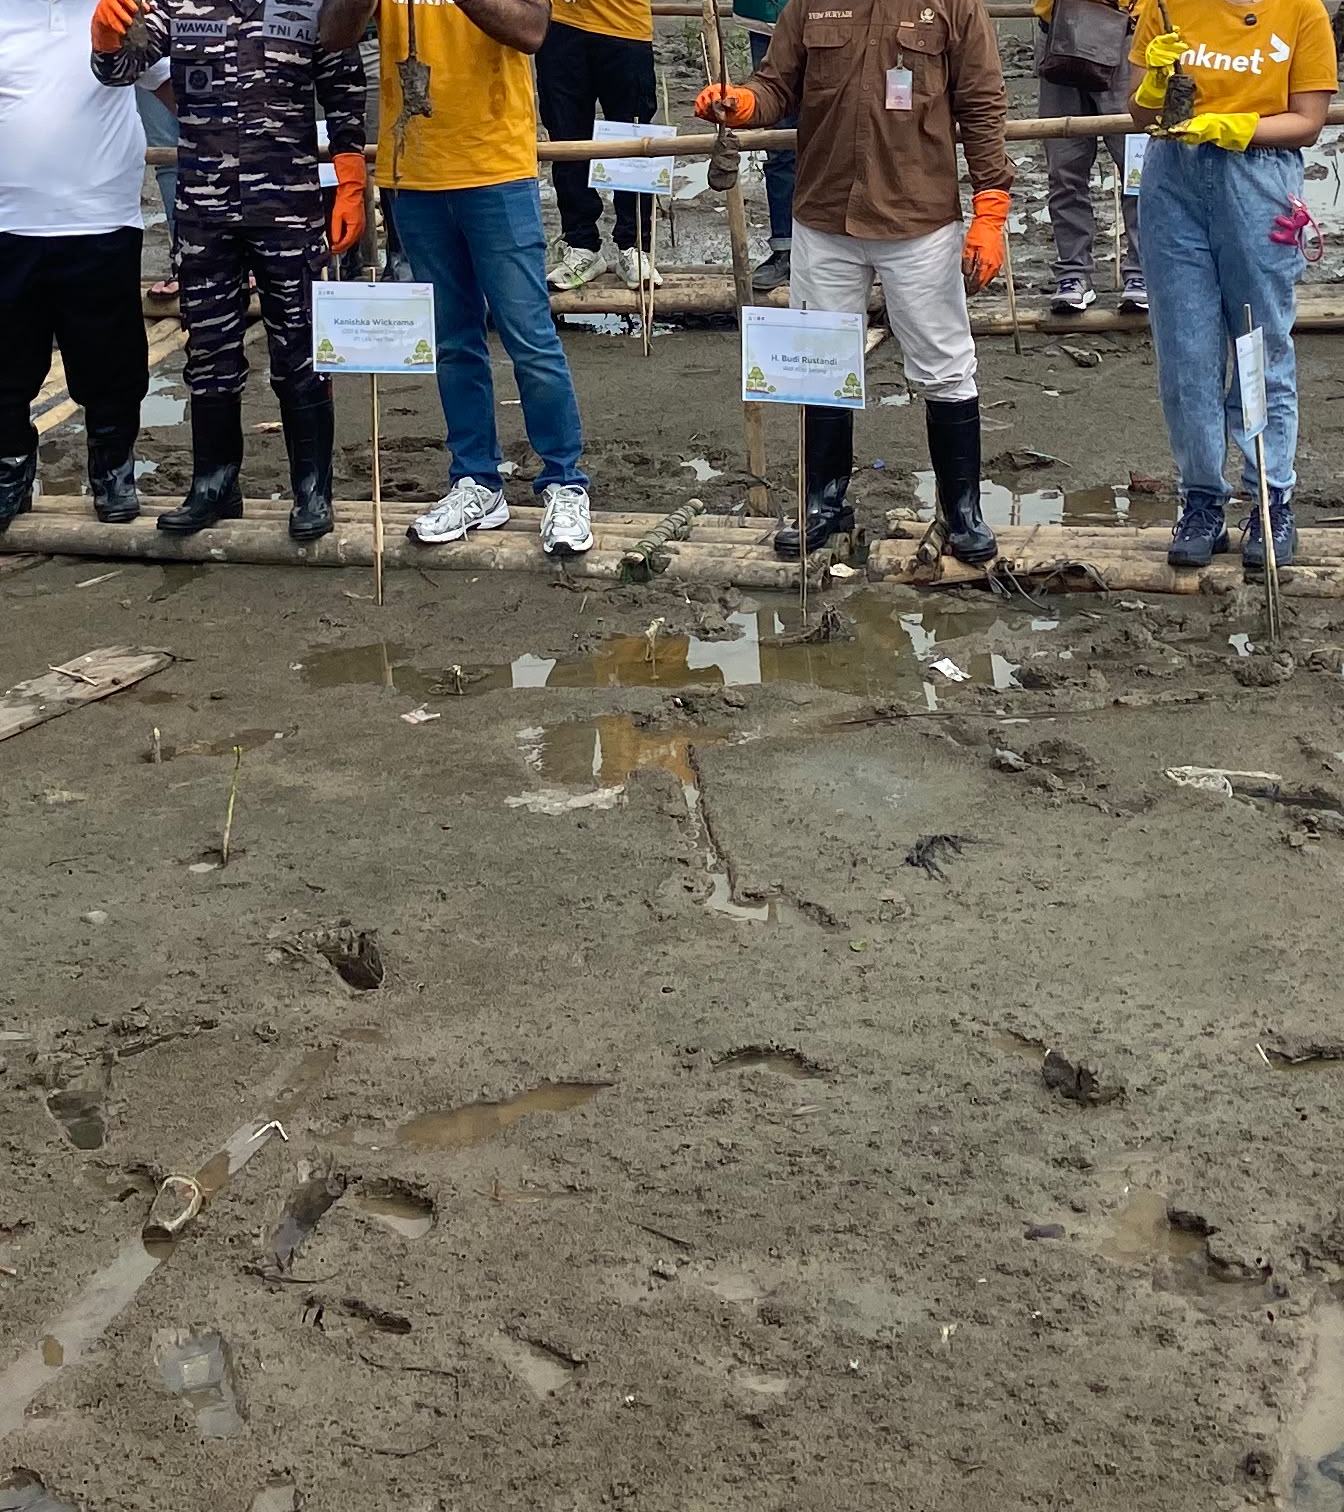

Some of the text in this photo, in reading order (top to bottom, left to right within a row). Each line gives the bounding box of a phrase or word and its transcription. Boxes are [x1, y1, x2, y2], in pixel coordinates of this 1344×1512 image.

[175, 22, 224, 34] WAWAN
[268, 24, 314, 42] TNI AL
[1179, 43, 1265, 75] nknet
[333, 317, 415, 326] Kanishka Wickrama
[781, 354, 800, 362] Budi
[801, 356, 838, 365] Rustandi
